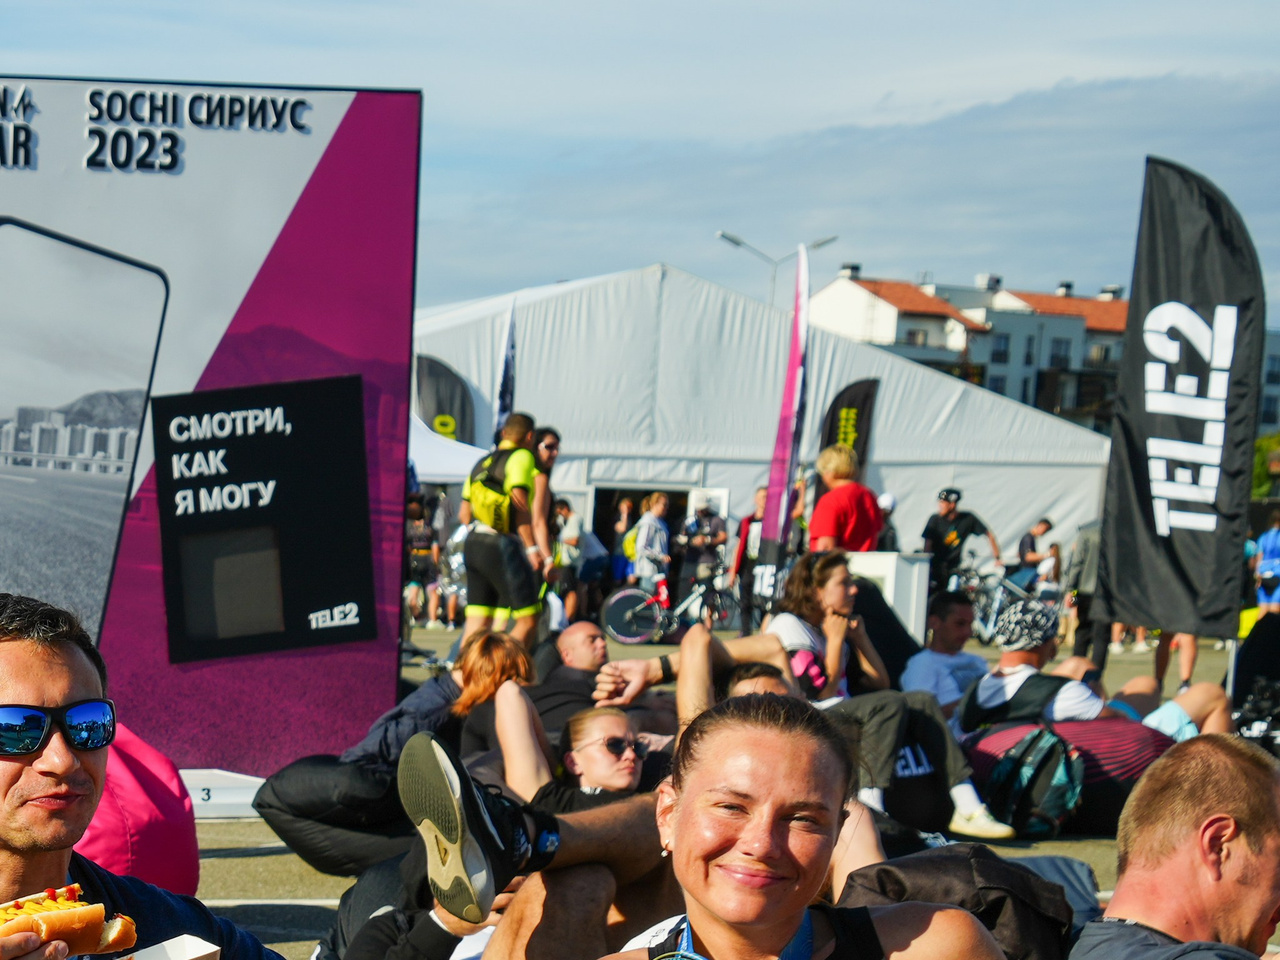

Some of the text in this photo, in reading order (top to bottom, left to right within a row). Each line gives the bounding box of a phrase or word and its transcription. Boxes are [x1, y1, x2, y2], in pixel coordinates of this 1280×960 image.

[87, 88, 312, 132] SOCHI СИРИУС
[85, 127, 183, 172] 2023
[169, 406, 293, 443] СМОТРИ,
[1143, 301, 1238, 537] TELE2
[172, 448, 229, 480] КАК
[175, 480, 277, 516] Я МОГУ
[309, 602, 360, 630] TELE2
[201, 788, 211, 801] 3
